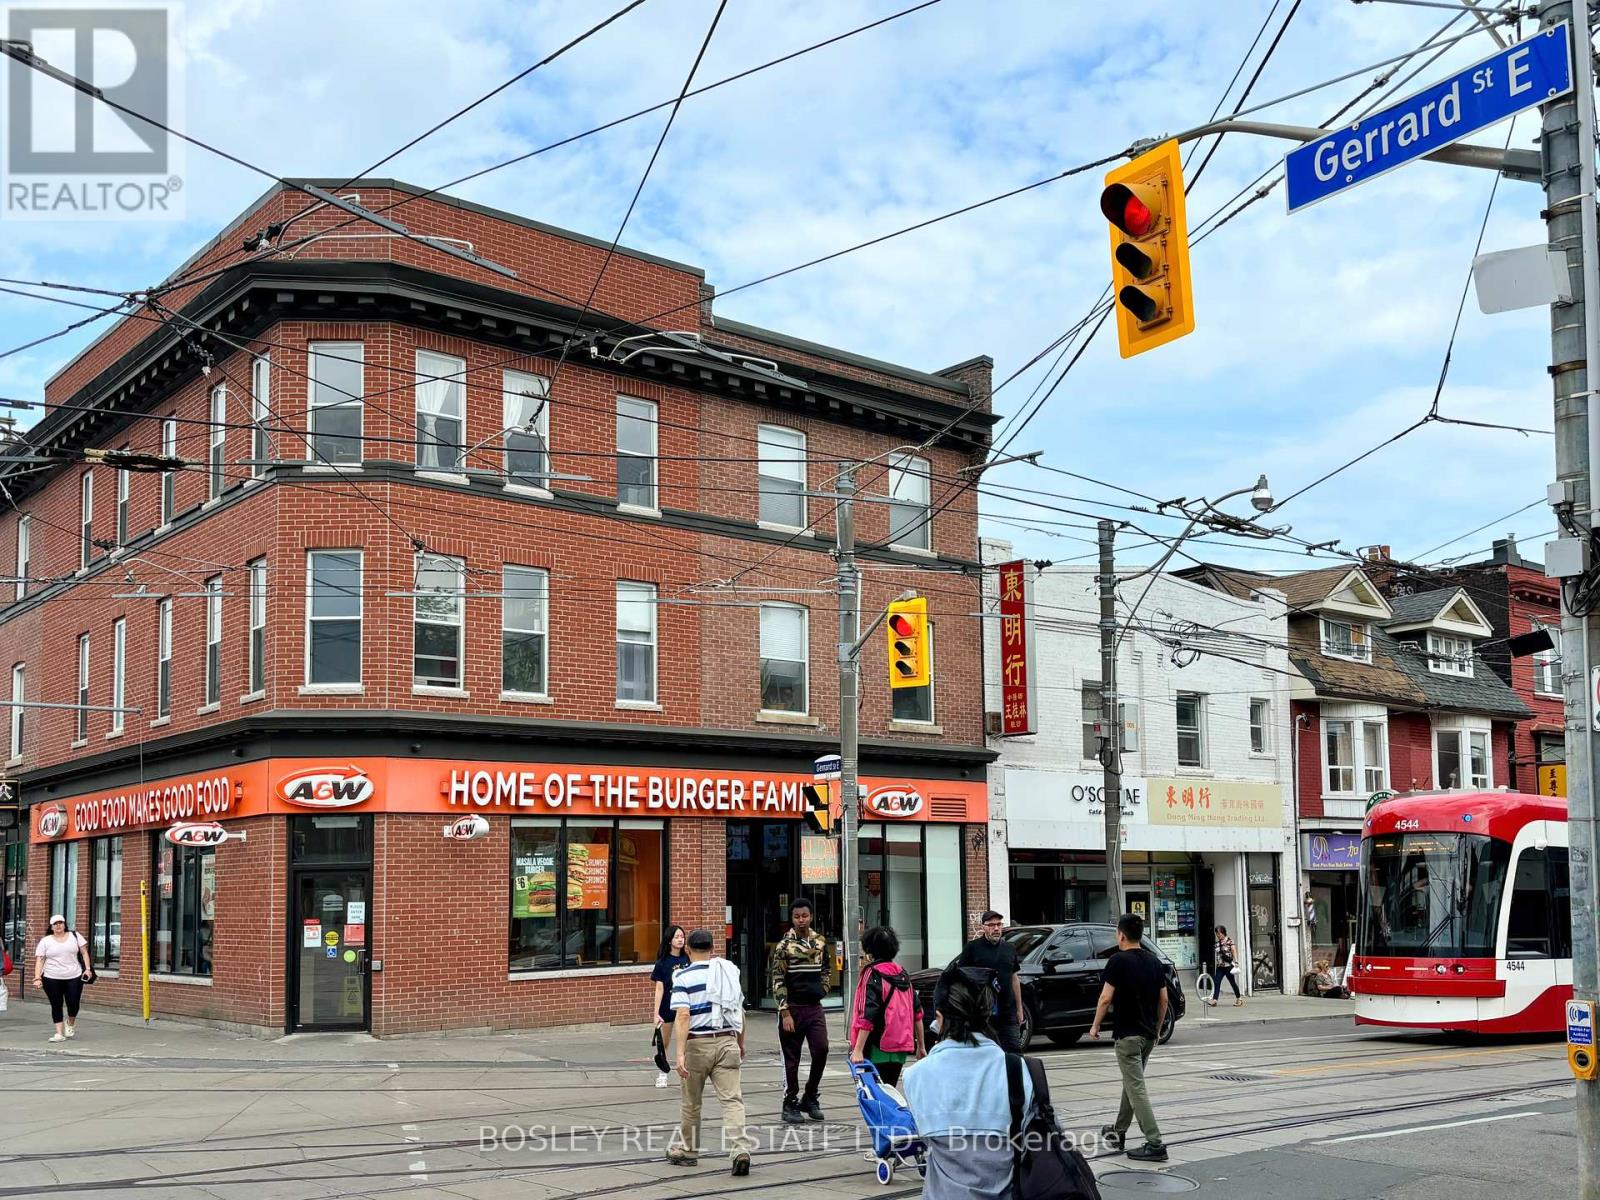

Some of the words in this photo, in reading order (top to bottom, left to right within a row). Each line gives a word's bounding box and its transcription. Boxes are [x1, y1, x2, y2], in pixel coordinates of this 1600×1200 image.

[1313, 81, 1461, 182] Gerrard
[1473, 67, 1493, 94] St
[1507, 47, 1533, 97] E
[1004, 568, 1024, 687] 東明行
[289, 780, 368, 801] A&W
[450, 770, 535, 807] HOME
[544, 773, 581, 807] OF
[590, 774, 639, 808] THE
[648, 776, 745, 811] BURGER
[752, 781, 814, 812] FAMIL
[1166, 785, 1211, 809] 東明行
[75, 802, 99, 832] GOOD
[101, 796, 126, 829] FOOD
[129, 788, 161, 825] MAKES
[163, 782, 194, 820] GOOD
[197, 776, 230, 815] FOOD
[876, 792, 919, 811] A&W
[43, 815, 59, 833] A&W
[454, 822, 475, 836] A&W
[1395, 819, 1419, 830] 4544
[179, 830, 224, 842] A&W
[516, 857, 536, 866] MASALA
[536, 857, 554, 866] VEGGIE
[525, 866, 544, 874] BURGER
[1506, 961, 1525, 971] 4544
